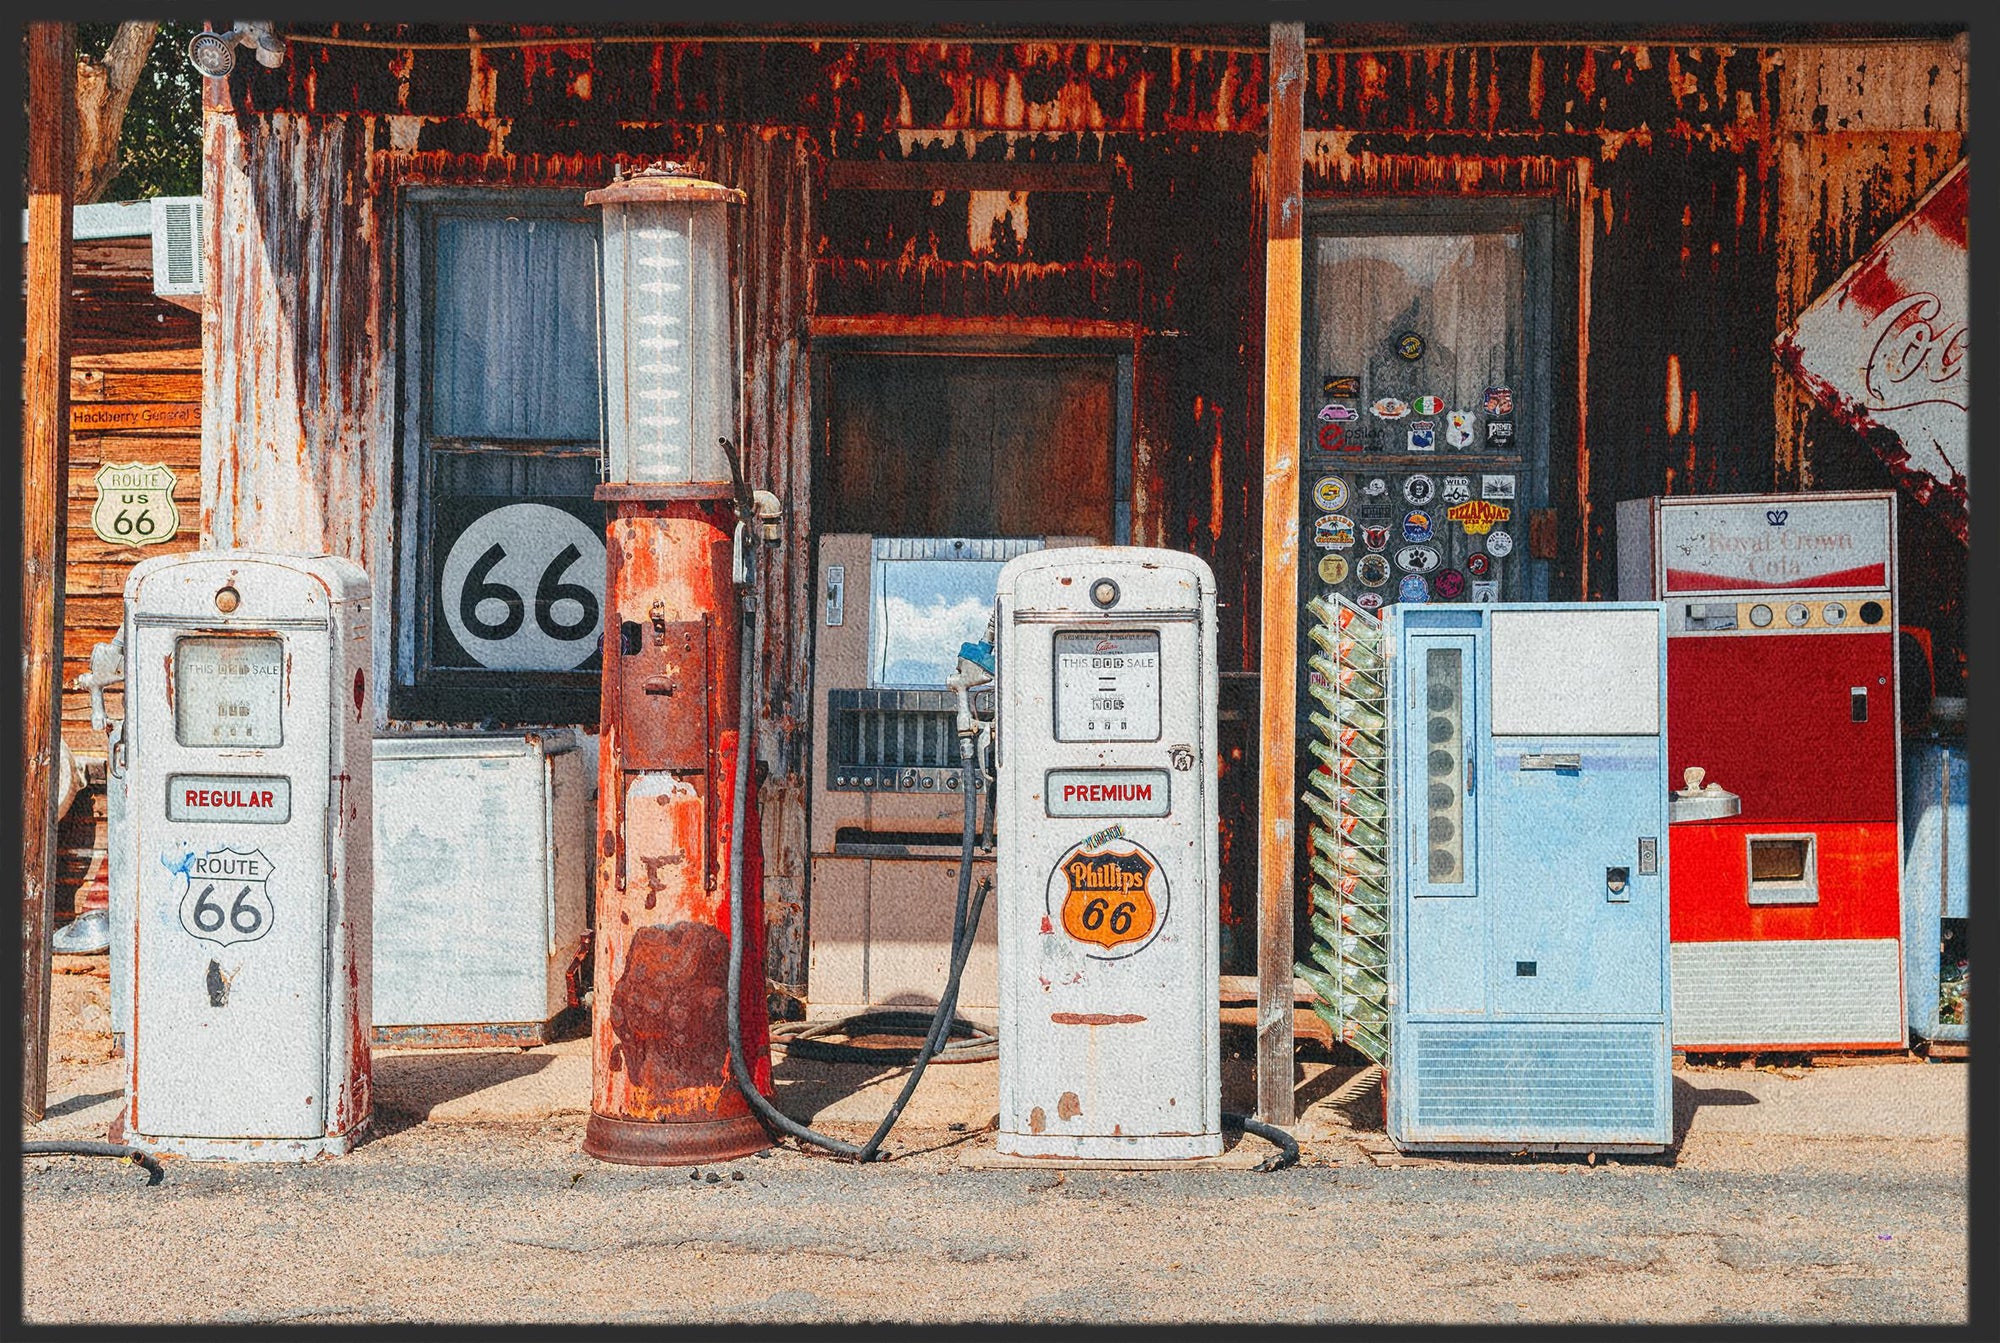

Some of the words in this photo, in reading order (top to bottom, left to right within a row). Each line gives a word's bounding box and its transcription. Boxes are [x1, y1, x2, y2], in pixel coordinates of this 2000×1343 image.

[73, 411, 139, 424] Hackberry
[142, 409, 190, 421] General
[112, 474, 159, 487] ROUTE
[121, 494, 149, 504] US
[1449, 501, 1509, 521] PIZZAPOJAT
[113, 509, 155, 535] 66
[1709, 530, 1772, 554] Royal
[1781, 528, 1853, 551] Crown
[1748, 556, 1800, 577] Cola
[460, 542, 600, 641] 66
[189, 664, 214, 674] THIS
[252, 664, 280, 675] SALE
[1063, 658, 1088, 668] THIS
[1127, 658, 1154, 668] SALE
[185, 790, 274, 807] REGULAR
[1064, 785, 1152, 802] PREMIUM
[196, 858, 259, 875] ROUTE
[1070, 862, 1144, 895] Phillips
[193, 884, 262, 934] 66
[1082, 898, 1136, 935] 66
